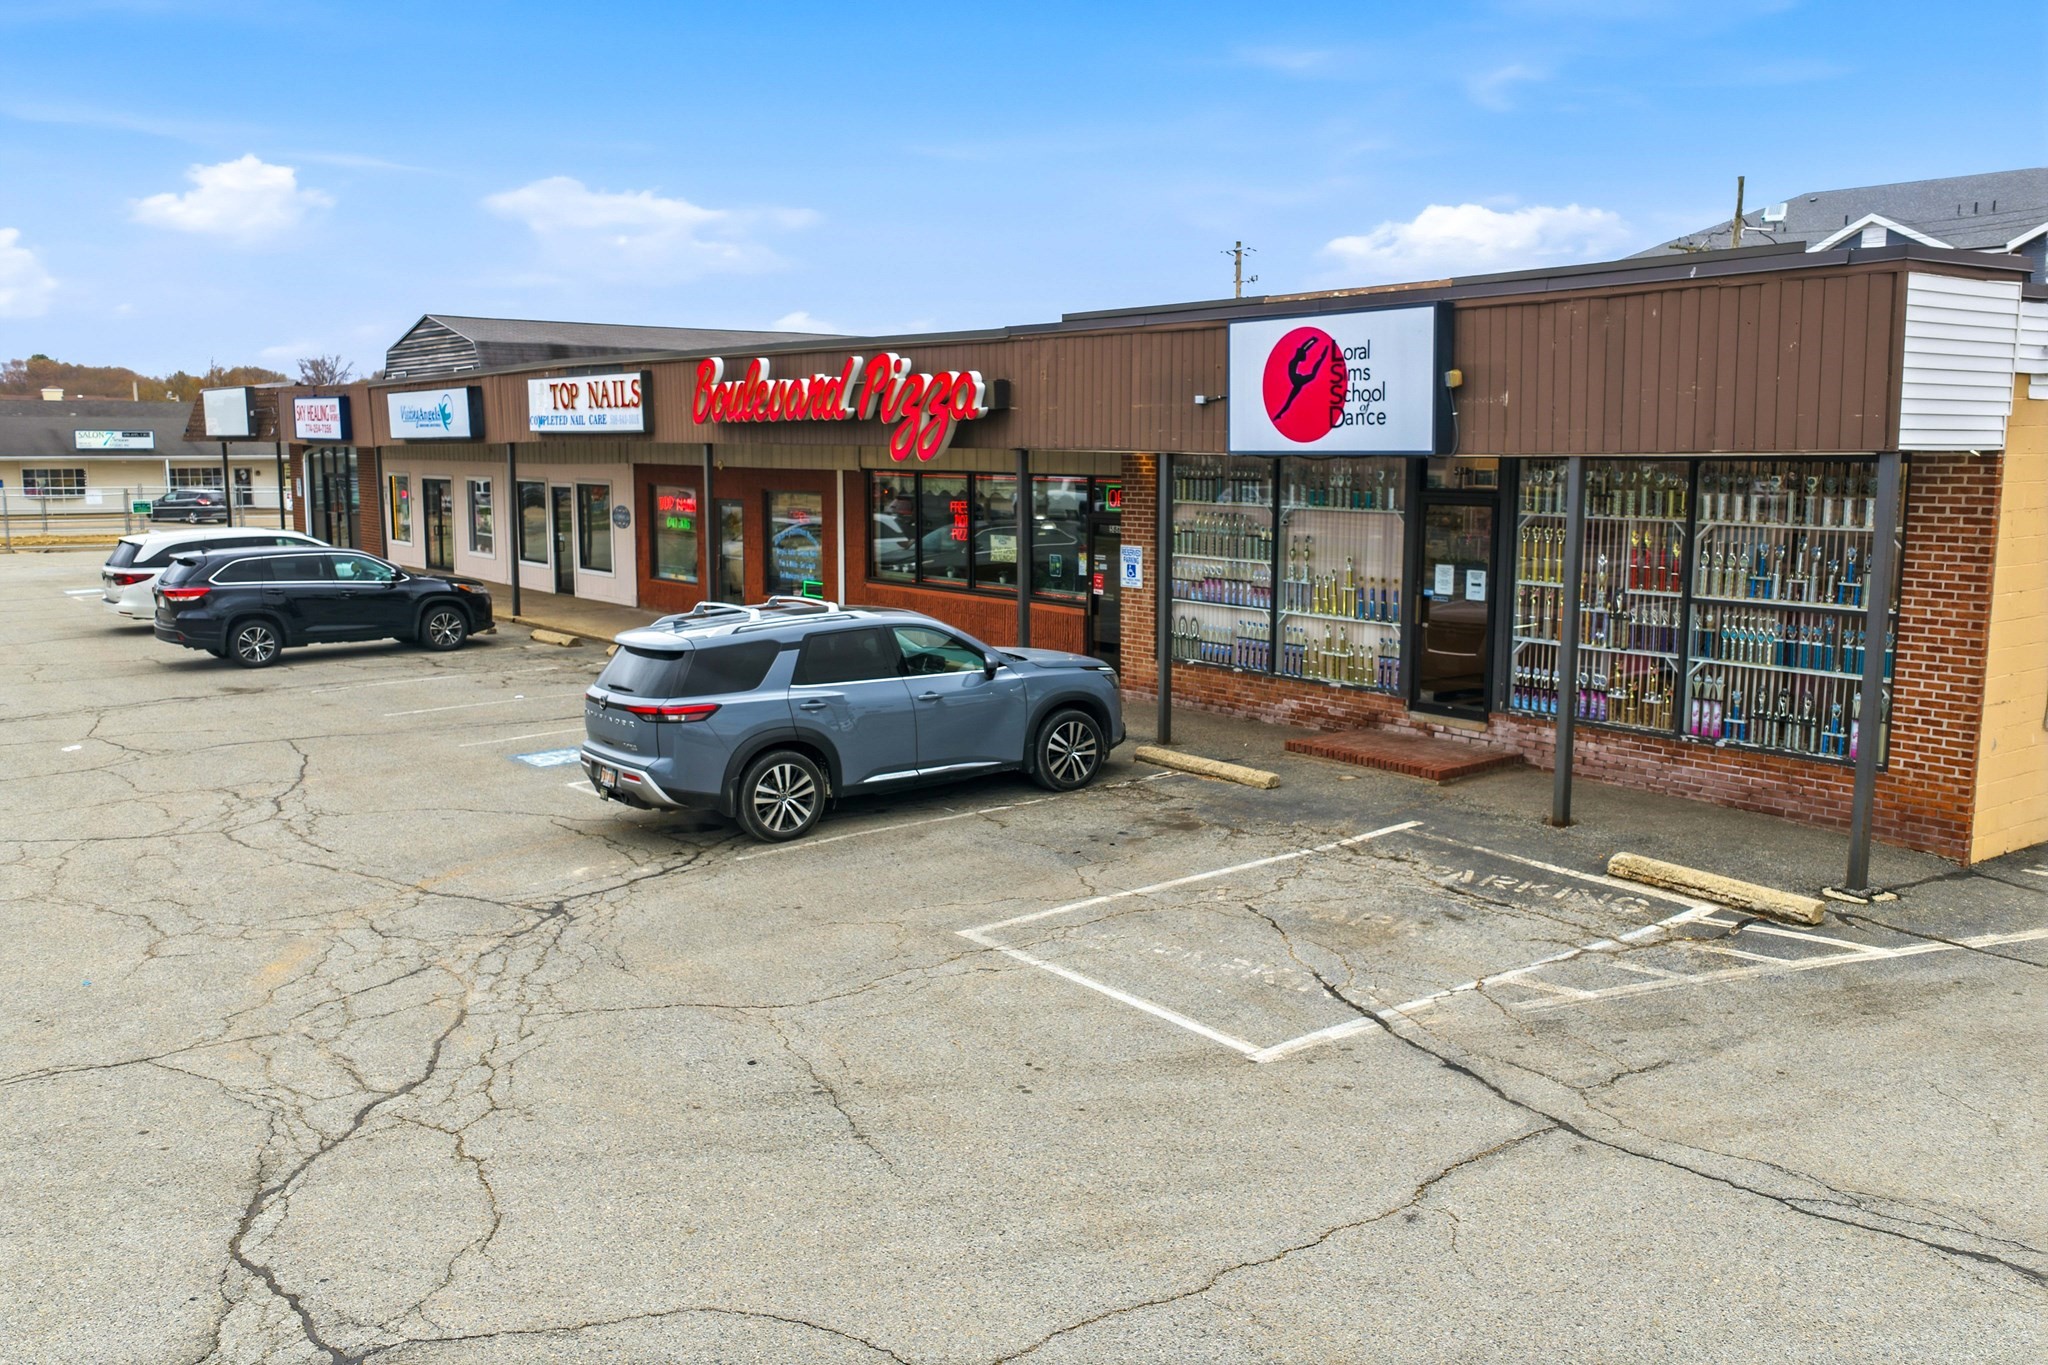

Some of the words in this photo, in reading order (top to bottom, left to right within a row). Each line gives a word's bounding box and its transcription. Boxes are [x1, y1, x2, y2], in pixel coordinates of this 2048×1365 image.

[1330, 339, 1370, 362] Loral
[1329, 363, 1371, 385] Sims
[549, 382, 579, 410] TOP
[587, 379, 641, 408] NAILS
[1329, 381, 1385, 405] School
[307, 405, 329, 421] HEALING
[420, 407, 441, 421] Angels
[693, 357, 862, 425] Boulevard
[858, 352, 988, 462] Pizza
[1360, 400, 1373, 414] of
[530, 414, 568, 427] COMPLETED
[570, 414, 585, 425] NAIL
[589, 413, 607, 425] CARE
[1329, 405, 1386, 428] Dance
[78, 431, 104, 439] SALON
[103, 431, 114, 446] 7
[659, 496, 675, 511] TOP
[1121, 549, 1141, 557] RESERVED
[1123, 556, 1140, 565] PARKING
